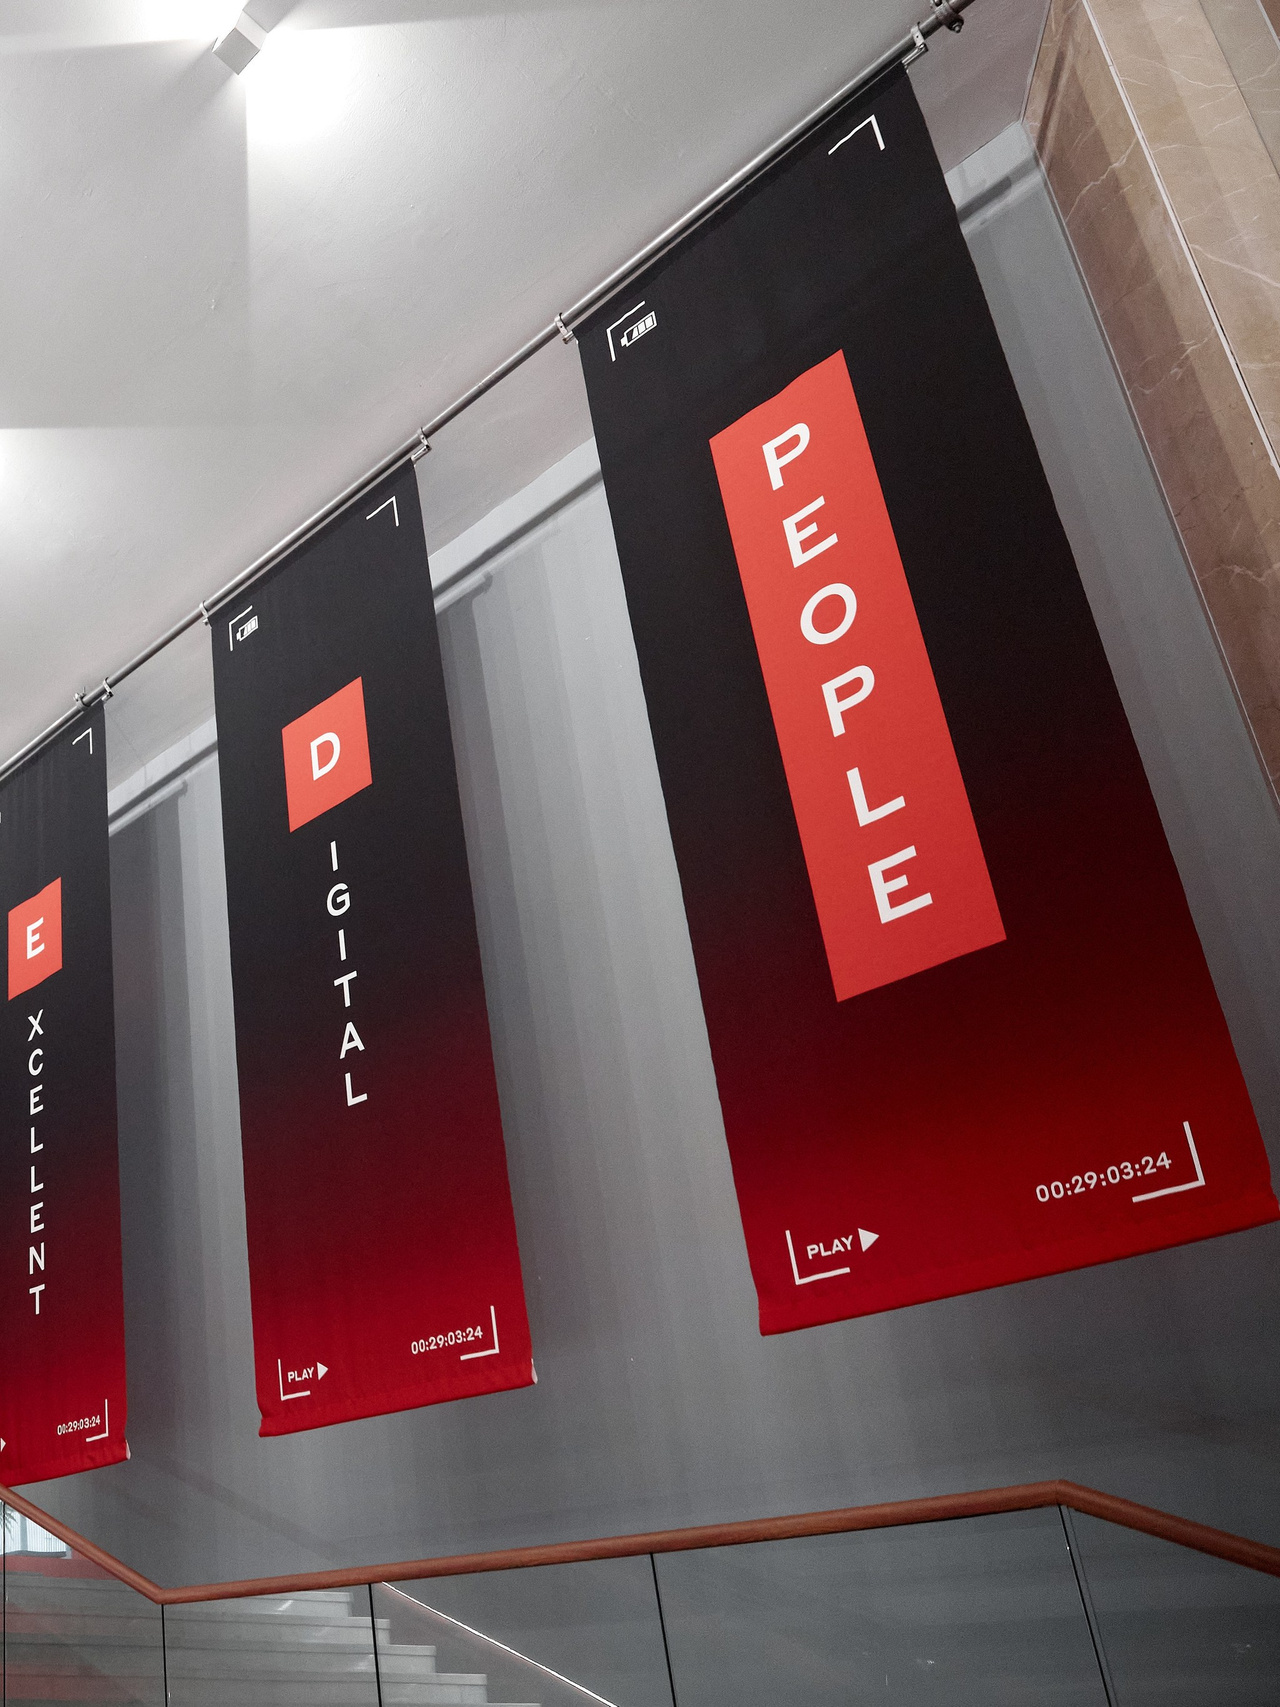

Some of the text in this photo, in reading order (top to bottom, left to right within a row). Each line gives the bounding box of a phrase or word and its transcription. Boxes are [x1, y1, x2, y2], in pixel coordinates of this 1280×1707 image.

[761, 422, 933, 924] PEOPLE
[1035, 1151, 1173, 1203] 00:29:03:24
[806, 1234, 854, 1260] PLAY
[410, 1325, 484, 1355] 00:29:03:24
[287, 1366, 315, 1383] PLAY
[57, 1414, 101, 1436] 00:29:03:24
